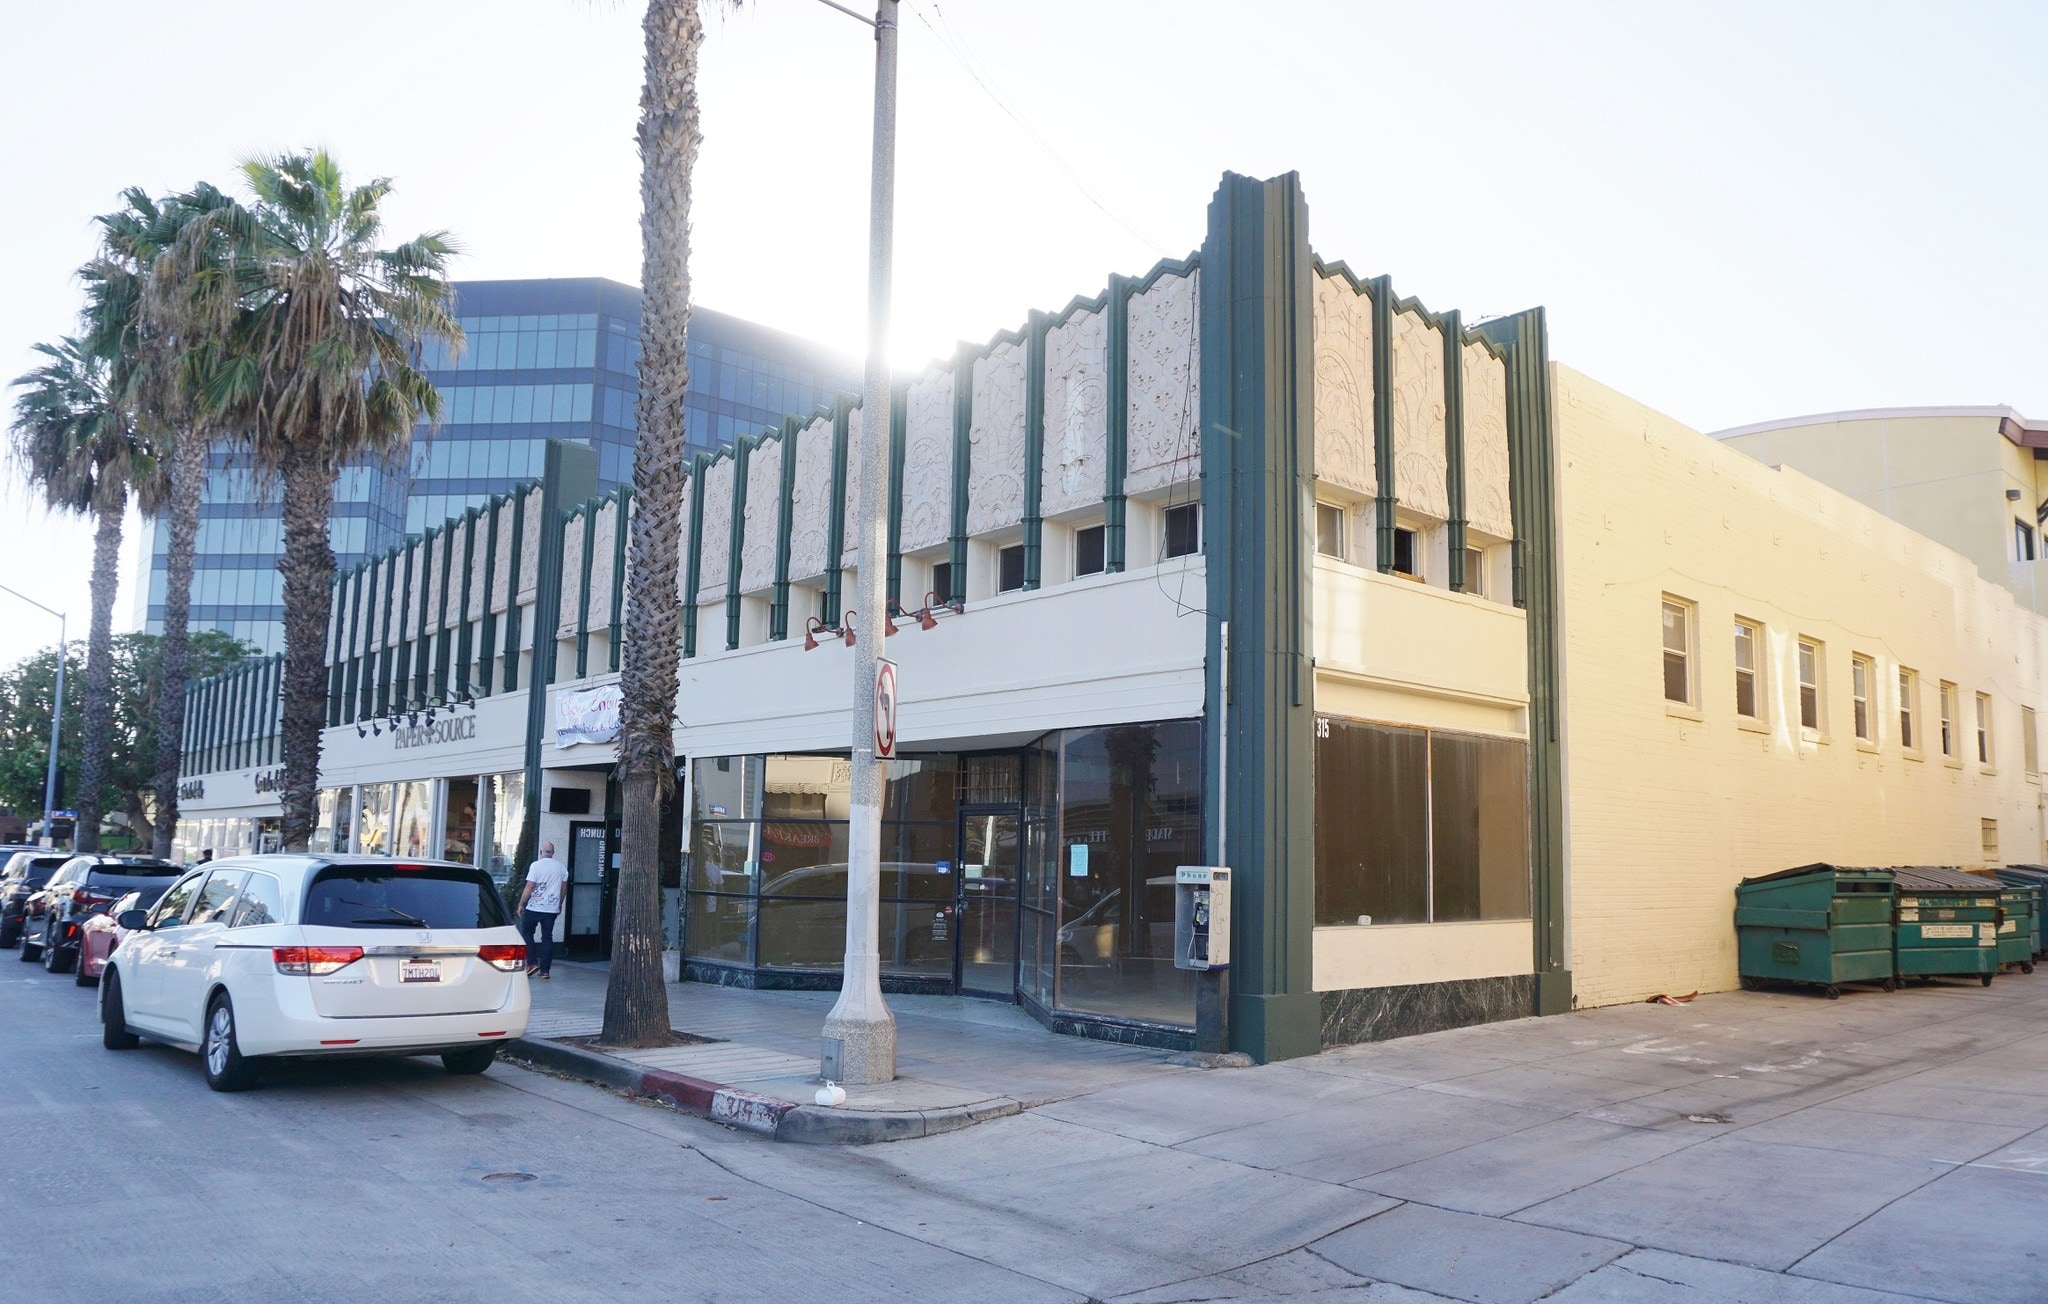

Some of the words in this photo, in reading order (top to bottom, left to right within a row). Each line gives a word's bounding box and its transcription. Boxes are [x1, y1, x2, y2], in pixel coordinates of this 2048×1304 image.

[395, 724, 425, 749] PAPER
[434, 715, 476, 744] SOURCE
[1317, 718, 1329, 738] 315
